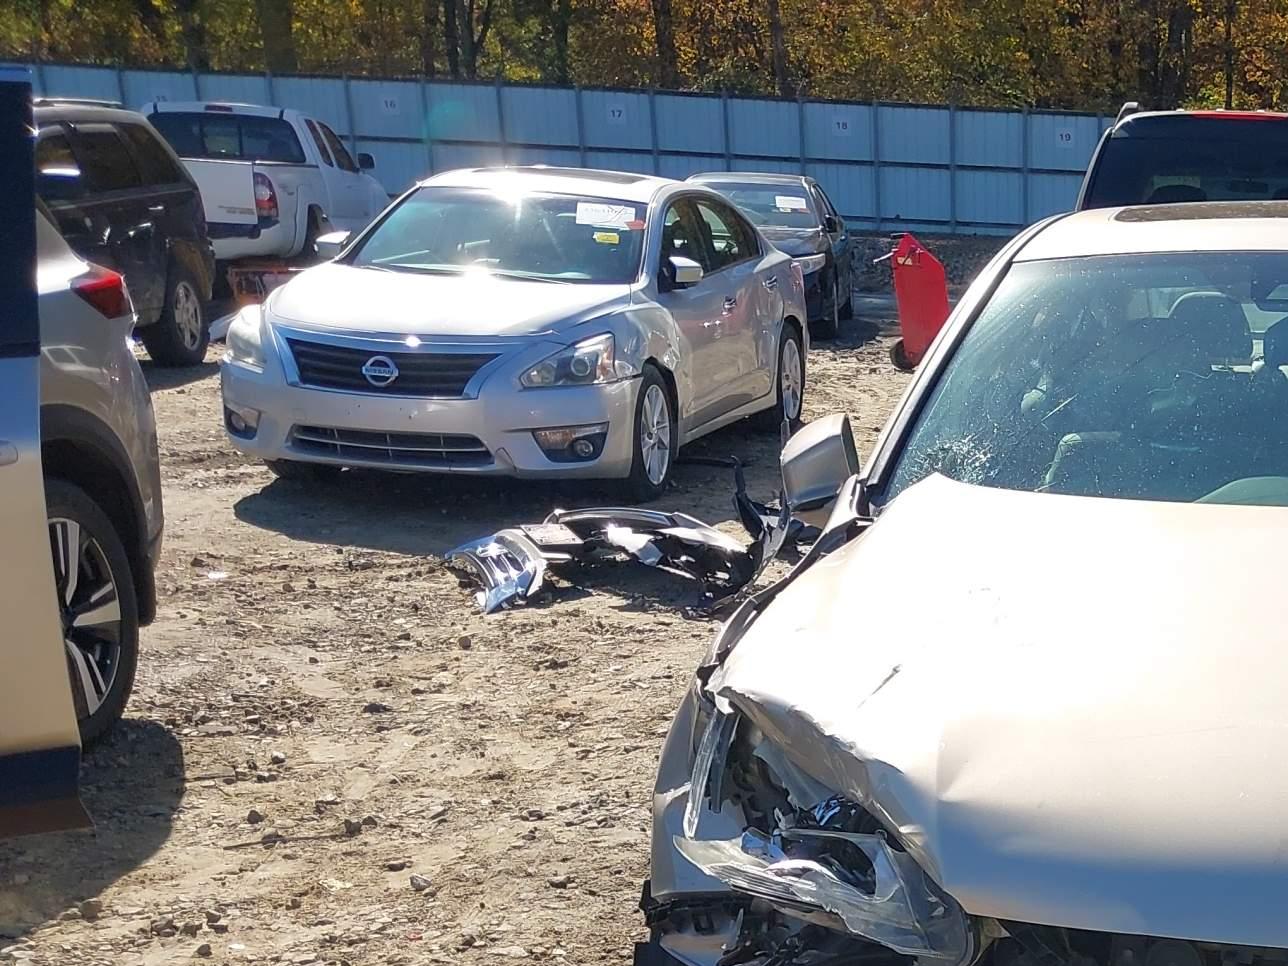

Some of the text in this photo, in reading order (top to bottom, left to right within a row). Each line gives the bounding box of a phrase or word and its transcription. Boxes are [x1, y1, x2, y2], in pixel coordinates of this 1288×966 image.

[610, 109, 623, 118] 17
[836, 121, 848, 130] 18
[1059, 133, 1071, 142] 19
[364, 367, 394, 376] NISSAN
